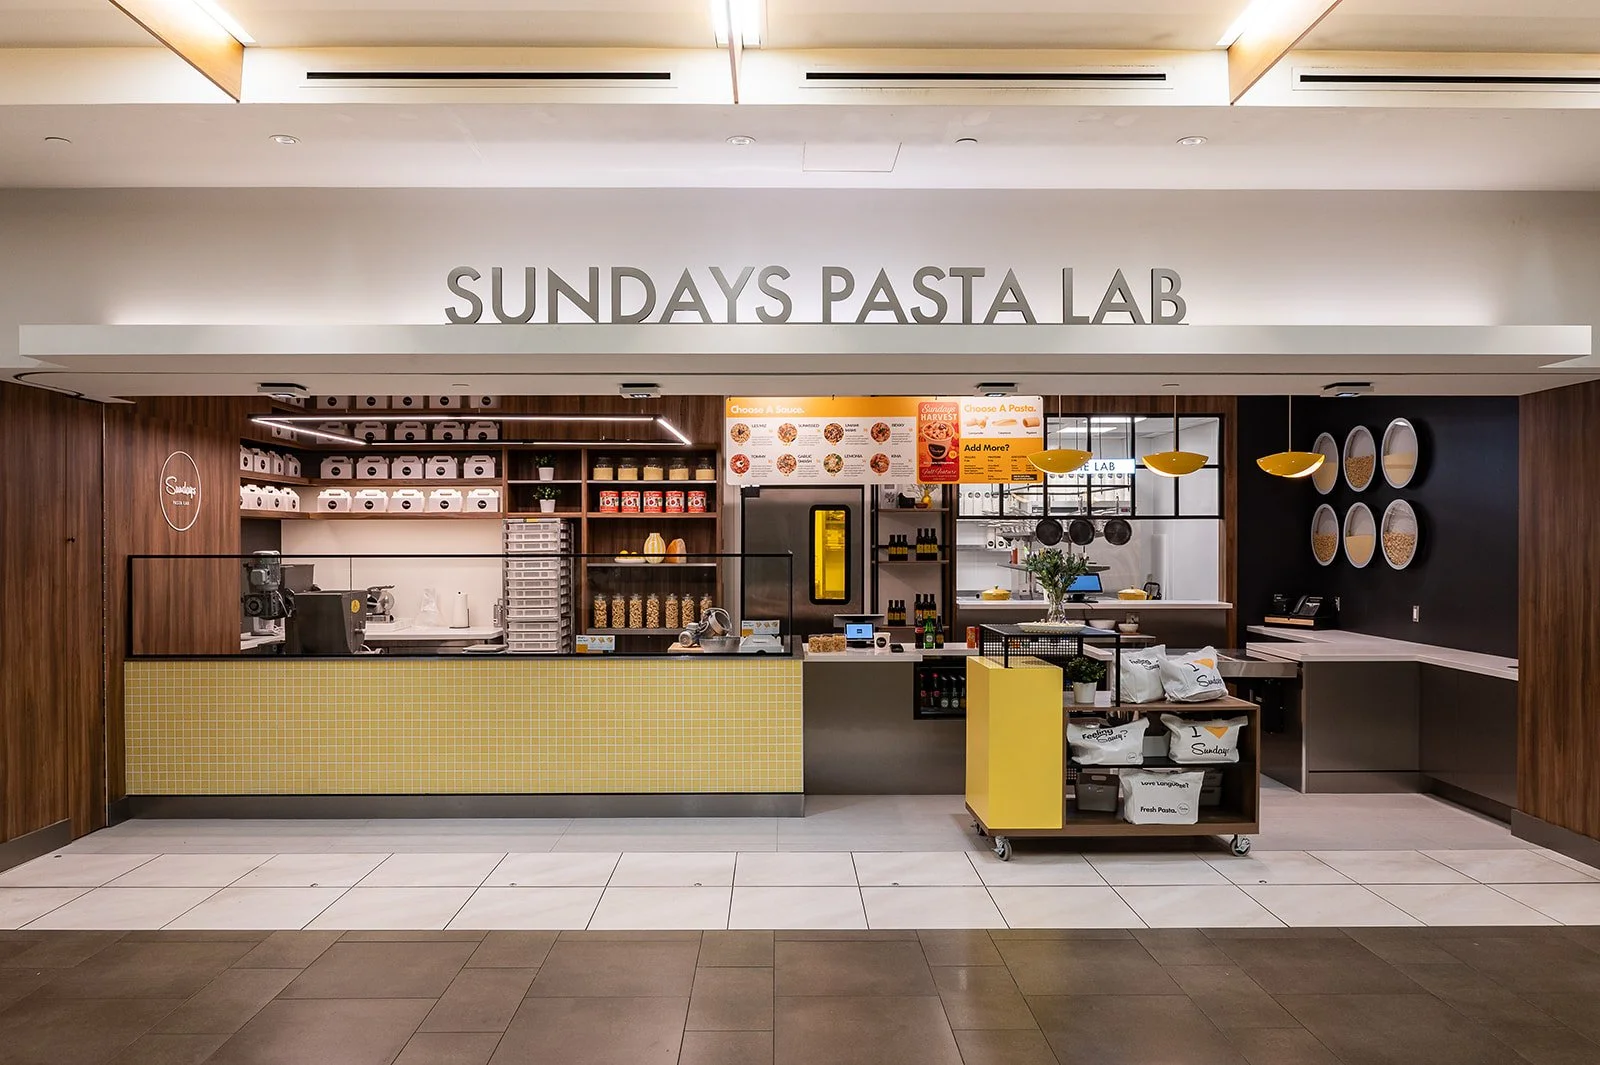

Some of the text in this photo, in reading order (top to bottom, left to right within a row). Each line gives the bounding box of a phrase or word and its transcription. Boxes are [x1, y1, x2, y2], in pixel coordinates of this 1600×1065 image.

[445, 266, 1188, 324] SUNDAYS PASTA LAB
[730, 405, 805, 414] Choose A Sauce.
[921, 403, 956, 415] Sundays
[964, 404, 1037, 413] Choose A Pasta.
[921, 413, 958, 421] HARVEST
[964, 444, 1010, 452] Add More?
[1094, 462, 1115, 471] LAB
[1082, 729, 1114, 740] Feeling
[1096, 729, 1128, 743] Saucy?
[1158, 806, 1178, 814] Pasta.
